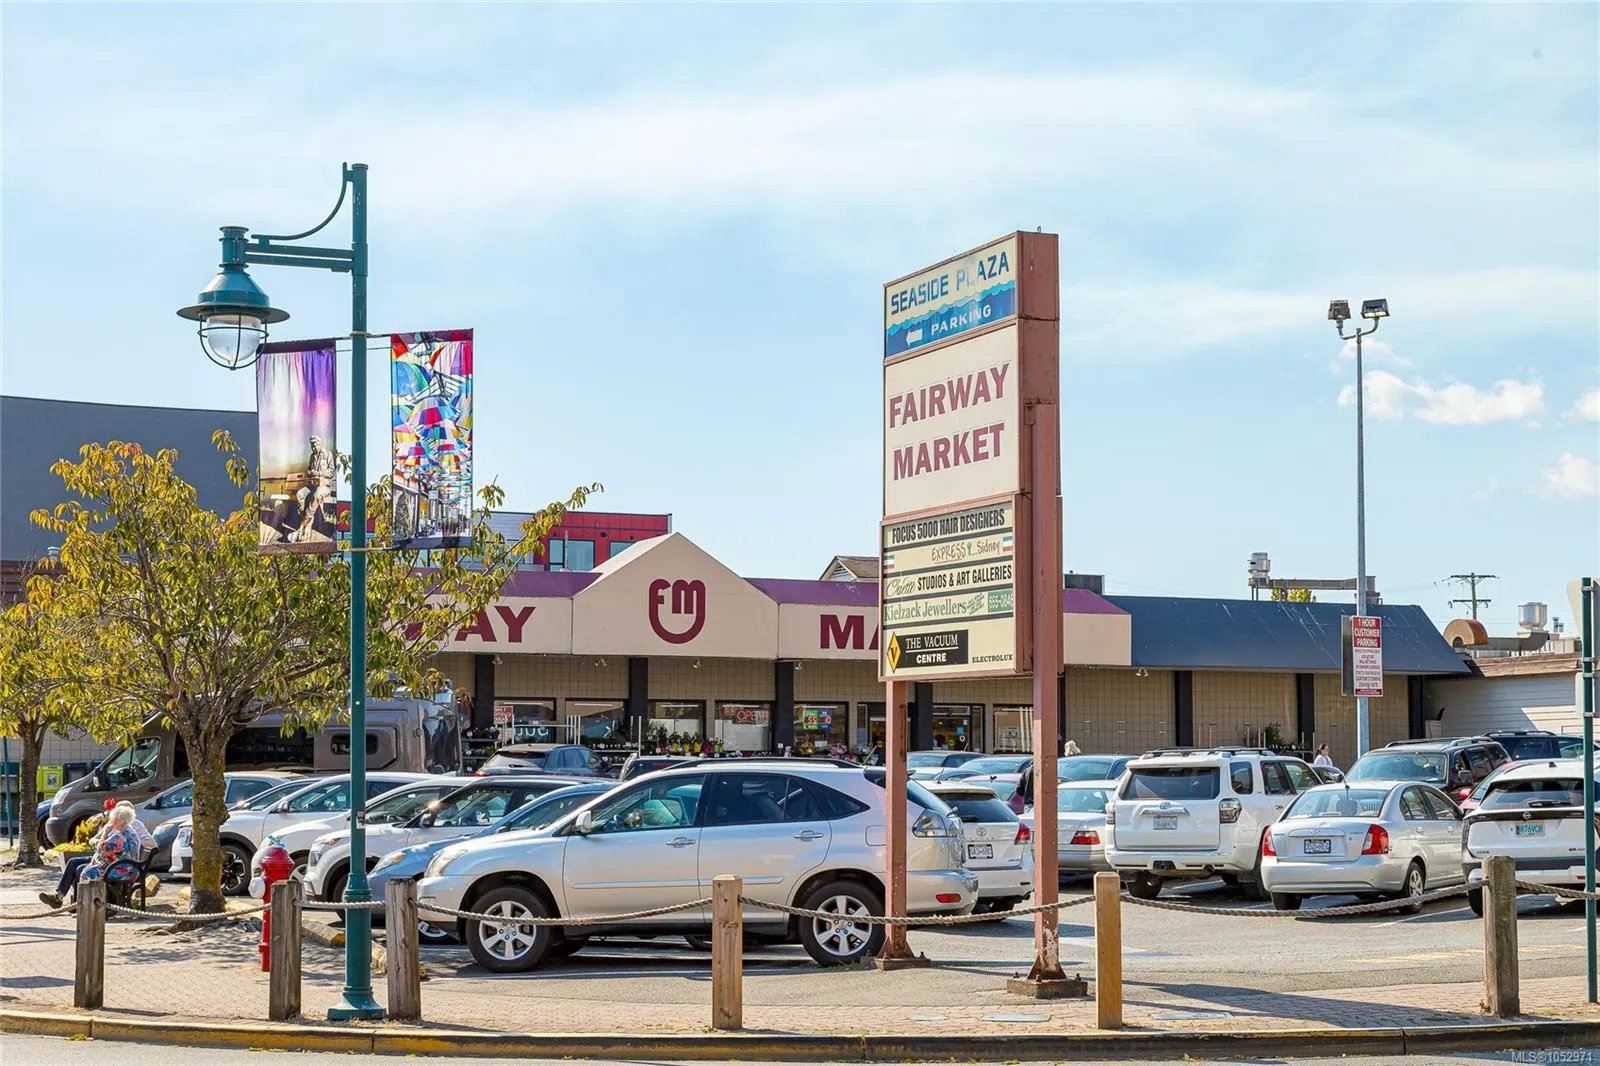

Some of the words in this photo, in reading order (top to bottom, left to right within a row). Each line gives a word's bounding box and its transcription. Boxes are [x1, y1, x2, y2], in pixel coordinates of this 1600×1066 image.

[891, 274, 949, 315] SEASIDE
[931, 305, 992, 336] PARKING
[889, 363, 1009, 428] FAIRWAY
[893, 422, 1005, 481] MARKET
[892, 524, 916, 544] FOCUS
[917, 520, 939, 539] 5000
[940, 516, 959, 536] HAIR
[960, 509, 1005, 532] DESIGNERS
[917, 574, 947, 591] STUDIOS
[949, 573, 954, 586] &
[956, 571, 970, 586] ART
[972, 565, 1012, 584] GALLERIES
[884, 603, 921, 622] Kielzack
[922, 598, 967, 617] Jewellers
[1354, 628, 1380, 637] CUSTOMER
[1362, 618, 1376, 627] HOUR
[905, 638, 922, 649] THE
[924, 634, 959, 648] VACUUM
[1356, 638, 1378, 647] PARKING
[891, 647, 898, 663] V
[916, 653, 947, 664] CENTRE
[972, 654, 1013, 663] ELECTROLUX
